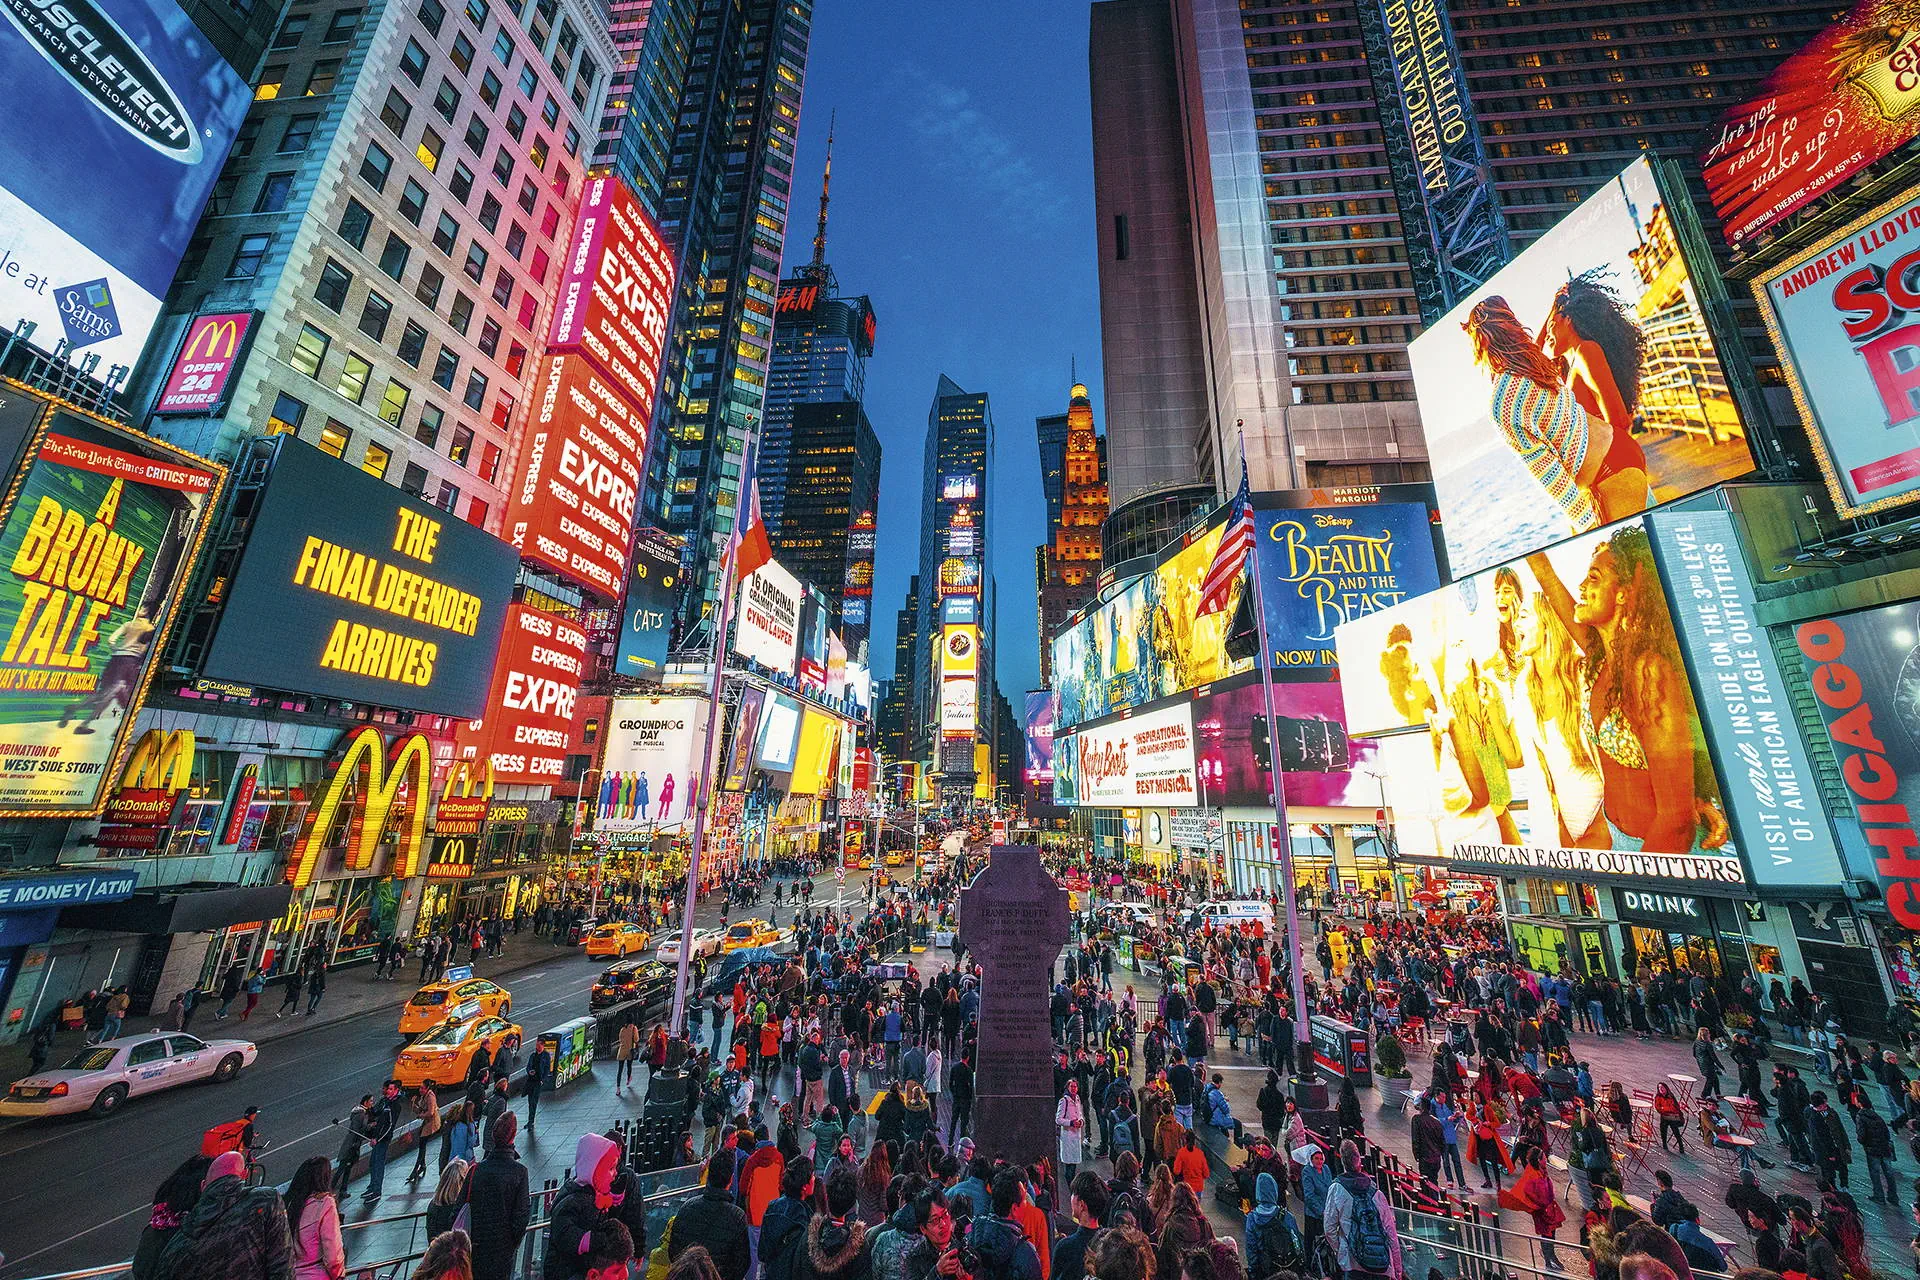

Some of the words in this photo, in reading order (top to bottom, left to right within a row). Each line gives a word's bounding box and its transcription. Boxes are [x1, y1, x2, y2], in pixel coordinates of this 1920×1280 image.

[69, 53, 80, 65] &
[79, 63, 152, 133] DEVELOPMENT
[1397, 54, 1449, 190] AMERICAN
[1705, 121, 1745, 167] Are
[1744, 98, 1778, 148] you
[1727, 113, 1777, 176] ready
[1782, 115, 1798, 137] to
[1743, 205, 1776, 235] IMPERIAL
[1774, 187, 1808, 214] THEATRE
[1810, 175, 1826, 190] 249
[1850, 151, 1865, 164] ST.
[573, 217, 596, 276] EXPRESS
[625, 201, 659, 254] EXPRESS
[1859, 205, 1920, 256] LLOYD
[617, 240, 652, 291] EXPRESS
[635, 239, 667, 288] EXPRESS
[24, 273, 49, 297] at
[776, 285, 818, 313] H&M
[60, 288, 114, 338] Sam's
[68, 316, 99, 339] CLUB
[557, 281, 581, 344] EXPRESS
[600, 317, 638, 365] EXPRESS
[620, 313, 655, 359] EXPRESS
[178, 374, 216, 392] 24
[182, 361, 225, 375] OPEN
[611, 356, 647, 401] EXPRESS
[162, 391, 218, 406] HOURS
[539, 355, 565, 424] EXPRESS
[588, 376, 629, 421] EXPRESS
[579, 423, 620, 465] EXPRESS
[600, 412, 637, 454] EXPRESS
[42, 437, 64, 454] The
[63, 443, 88, 461] New
[87, 450, 114, 468] York
[114, 456, 145, 476] Times
[188, 472, 212, 489] PICK
[520, 432, 548, 506] EXPRESS
[95, 476, 125, 527] A
[1333, 485, 1382, 496] MARRIOTT
[1334, 494, 1378, 503] MARQUIS
[392, 505, 442, 565] THE
[559, 515, 603, 553] EXPRESS
[581, 499, 622, 540] EXPRESS
[1311, 513, 1353, 529] Disney
[10, 494, 145, 608] BRONX
[1269, 520, 1394, 582] BEAUTY
[1674, 522, 1705, 570] LEVEL
[293, 535, 377, 605] FINAL
[374, 560, 482, 637] DEFENDER
[571, 553, 612, 588] EXPRESS
[941, 586, 978, 594] TOSHIBA
[1338, 576, 1367, 590] AND
[1370, 575, 1398, 589] THE
[751, 572, 762, 591] 16
[762, 579, 796, 616] ORIGINAL
[1297, 577, 1407, 641] BEAST
[1703, 541, 1754, 644] OUTFITTERS
[1, 580, 111, 670] TALE
[633, 609, 664, 632] CATS
[747, 608, 768, 632] CYNDI
[768, 617, 793, 646] LAUPER
[1697, 604, 1724, 636] THE
[319, 618, 438, 688] ARRIVES
[531, 644, 578, 676] EXPRESS
[1275, 649, 1316, 666] NOW
[1708, 641, 1734, 668] ON
[24, 669, 51, 690] NEW
[46, 671, 67, 691] HIT
[62, 672, 98, 692] MUSICAL
[1743, 648, 1773, 706] EAGLE
[619, 719, 685, 731] GROUNDHOG
[1718, 679, 1755, 735] INSIDE
[48, 746, 62, 758] OF
[514, 725, 562, 749] EXPRESS
[640, 729, 660, 740] DAY
[4, 758, 40, 772] WEST
[38, 760, 65, 773] SIDE
[1079, 734, 1104, 803] Kinky
[1102, 737, 1130, 779] Boots
[1733, 741, 1776, 808] aerie
[1754, 707, 1806, 811] AMERICAN
[1796, 618, 1920, 931] CHICAGO
[1135, 779, 1154, 794] BEST
[1155, 773, 1193, 794] MUSICAL
[107, 799, 171, 813] McDonald's
[113, 812, 157, 820] Restaurant
[438, 803, 486, 812] McDonald's
[488, 807, 528, 821] EXPRESS
[97, 833, 119, 841] OPEN
[129, 834, 155, 843] HOURS
[1758, 810, 1793, 866] VISIT
[1786, 813, 1815, 842] OF
[1452, 843, 1530, 869] AMERICAN
[1534, 848, 1593, 873] EAGLE
[1595, 850, 1745, 883] OUTFITTERS
[13, 884, 89, 903] MONEY
[95, 878, 134, 896] ATM
[1241, 904, 1261, 912] POLICE
[1624, 890, 1698, 917] DRINK
